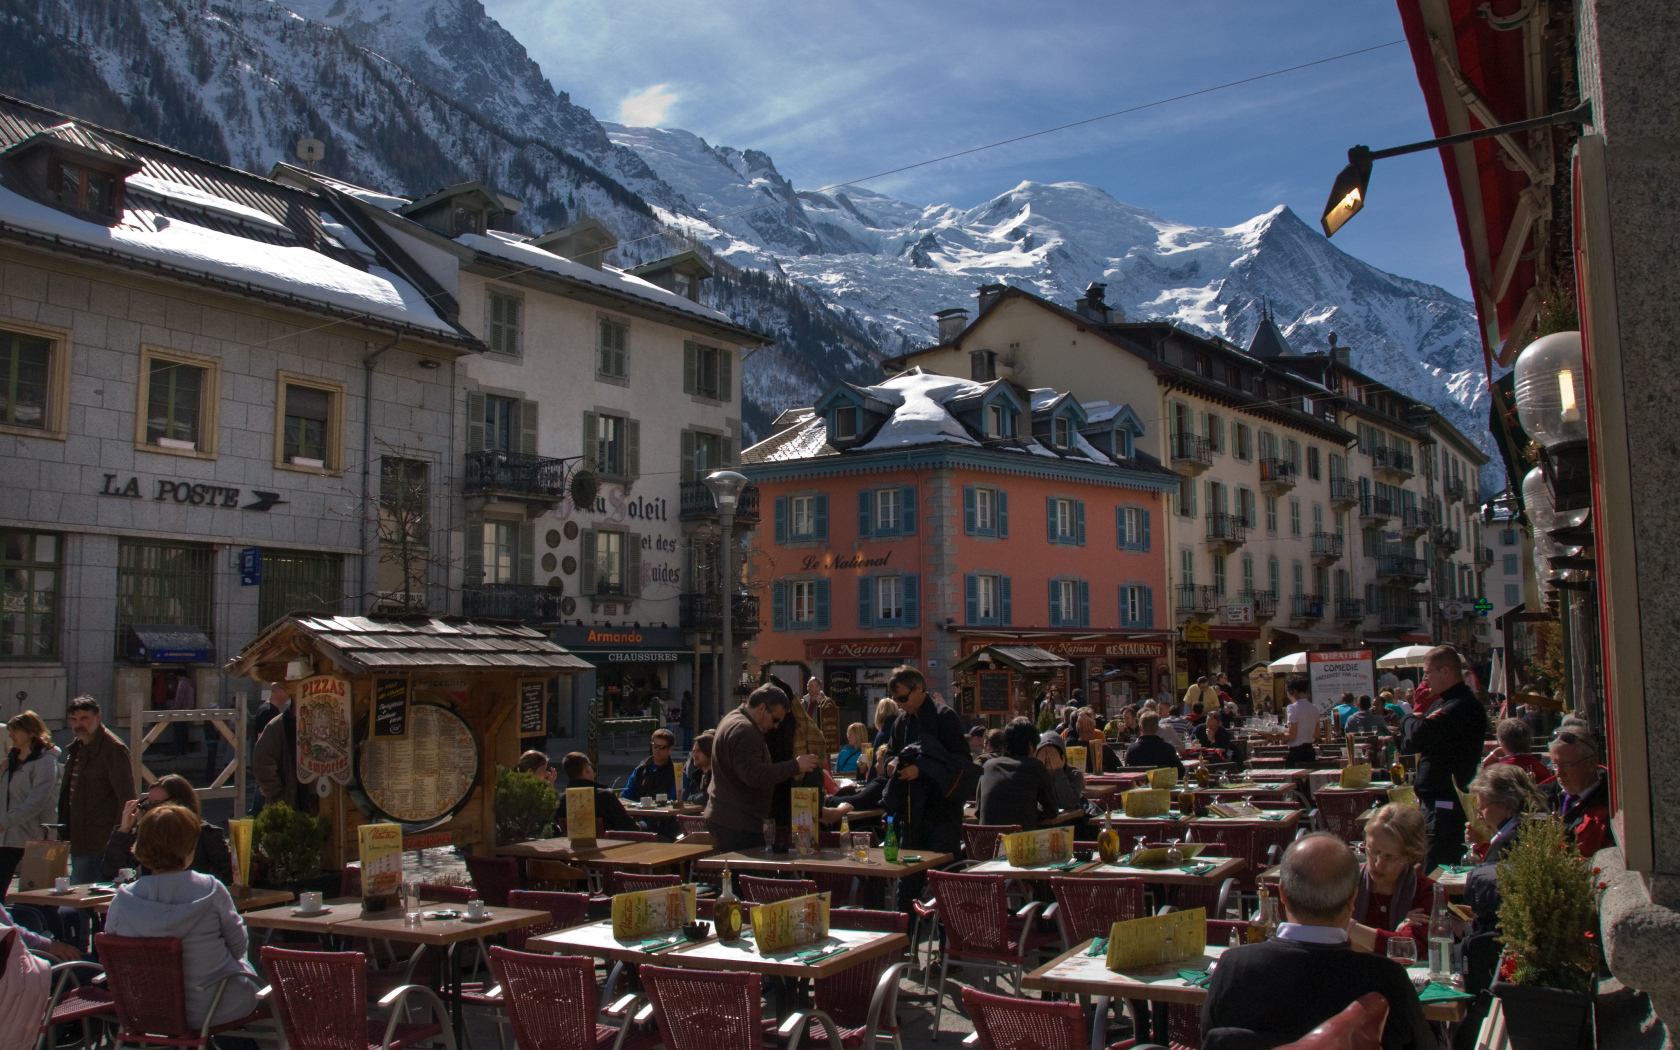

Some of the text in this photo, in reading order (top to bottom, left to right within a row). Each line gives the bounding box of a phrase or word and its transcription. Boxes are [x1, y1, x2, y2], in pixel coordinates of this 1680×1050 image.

[99, 473, 240, 508] LA POSTE
[603, 487, 667, 527] Soleil
[641, 534, 677, 553] et des
[800, 551, 892, 571] Le National
[587, 630, 642, 643] Armando
[608, 653, 678, 661] CHAUSSURES
[822, 643, 902, 657] le National
[1048, 643, 1162, 656] le National RESTAURANT
[302, 678, 345, 698] PIZZAS
[308, 754, 348, 777] emporter
